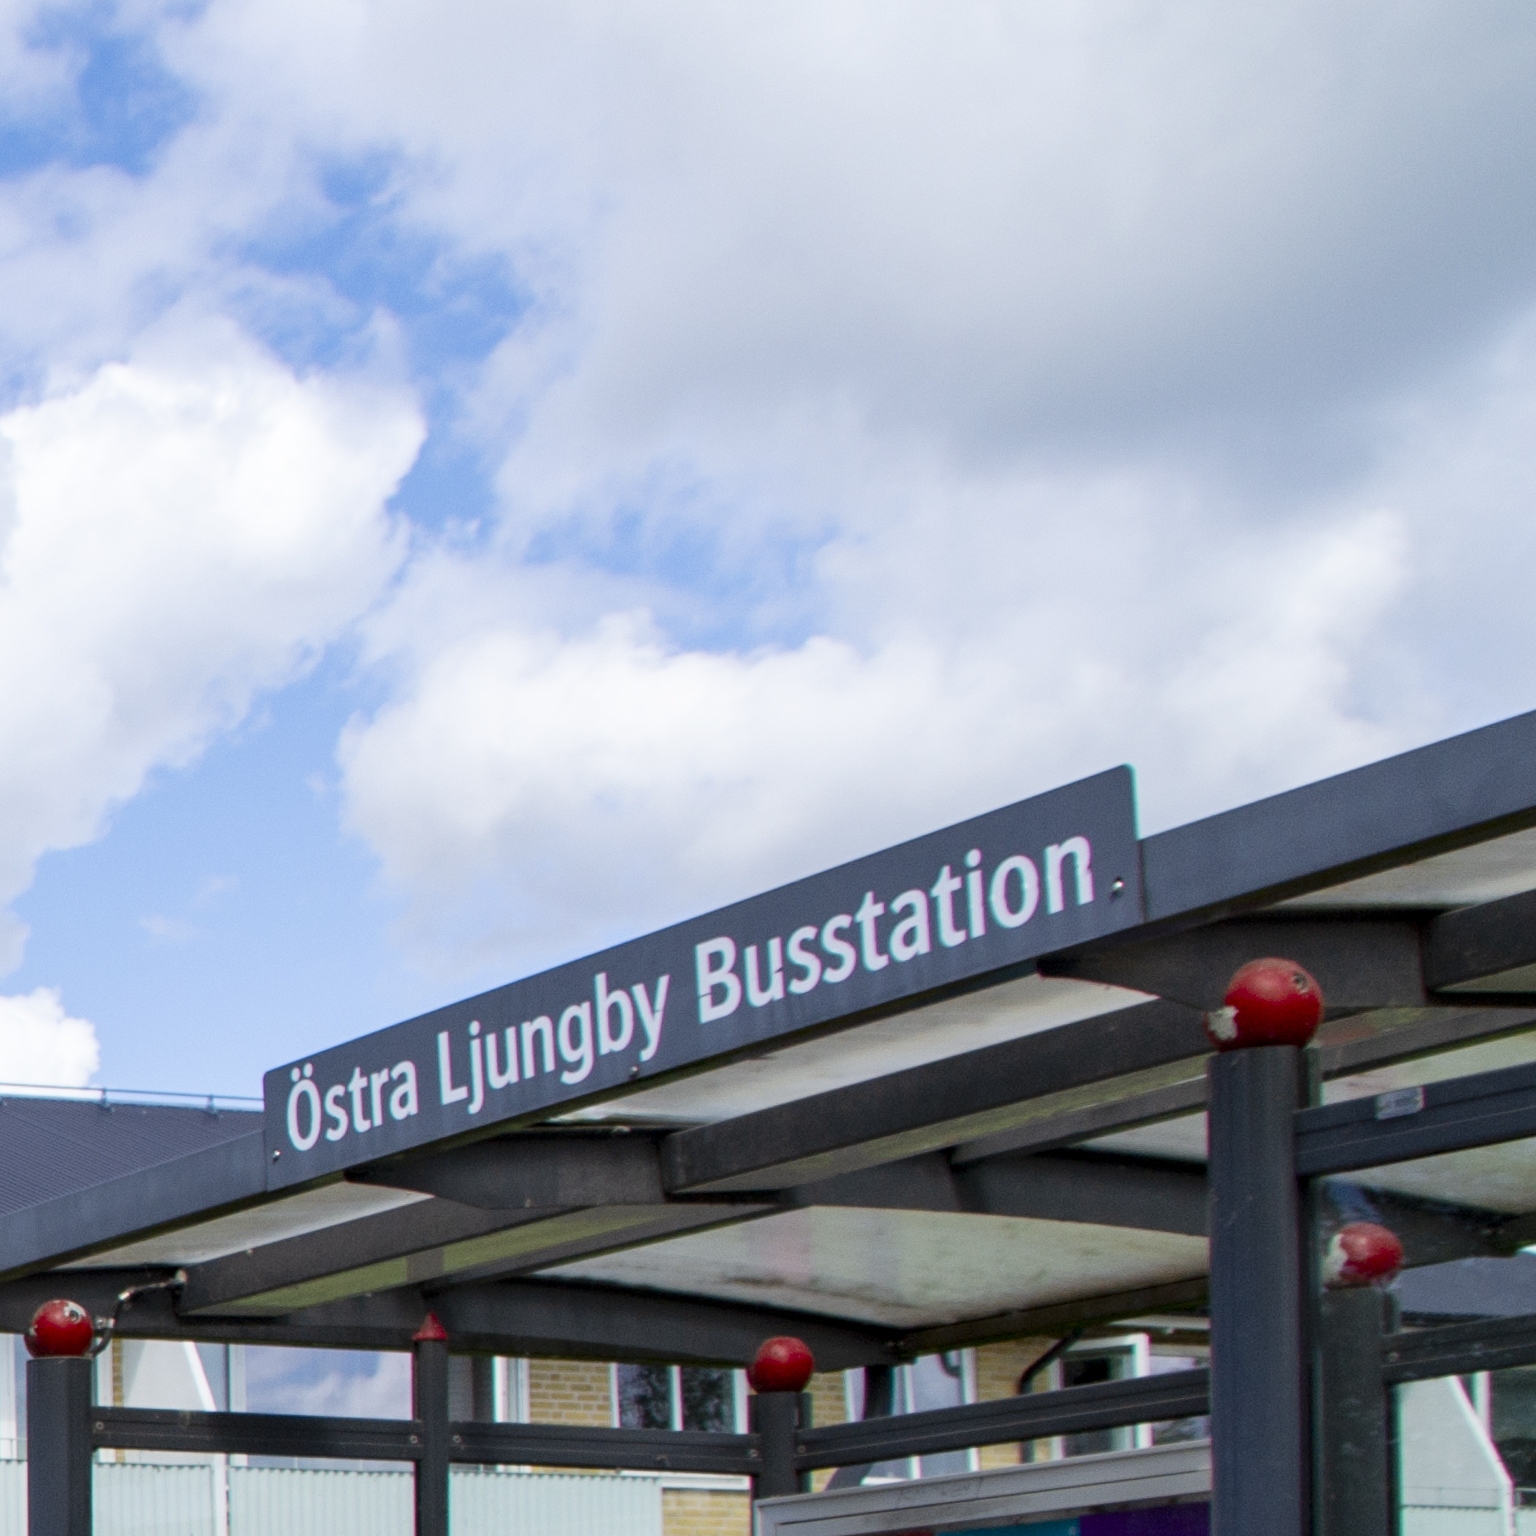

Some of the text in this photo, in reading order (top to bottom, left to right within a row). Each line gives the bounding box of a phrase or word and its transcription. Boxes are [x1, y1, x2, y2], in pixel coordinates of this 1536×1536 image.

[284, 834, 1097, 1152] Östra Ljungby Busstation
